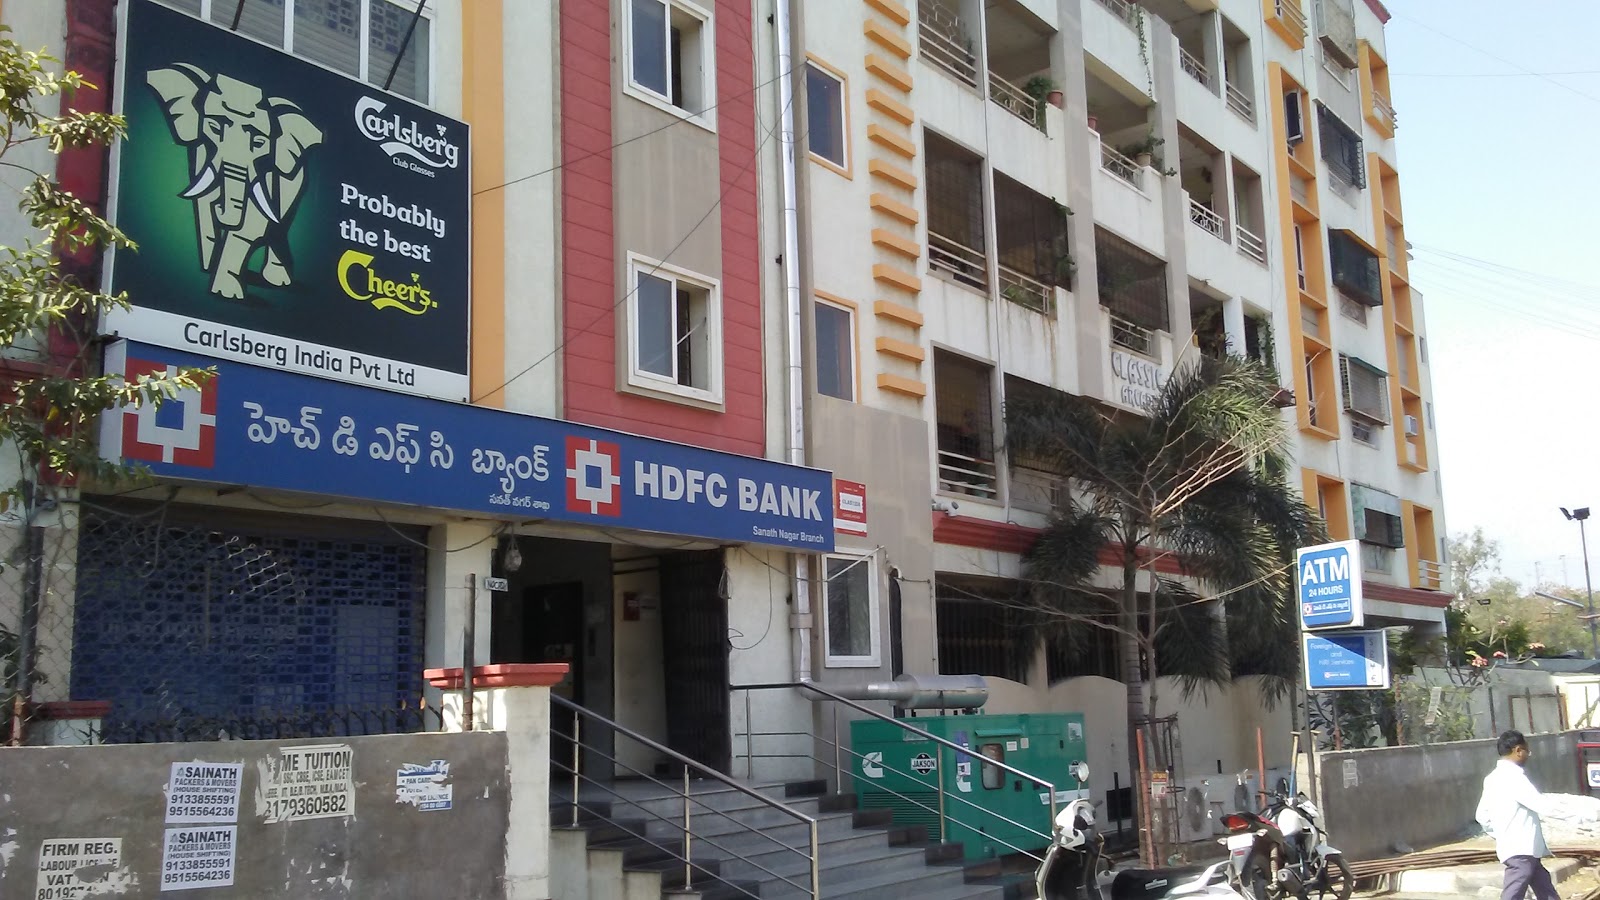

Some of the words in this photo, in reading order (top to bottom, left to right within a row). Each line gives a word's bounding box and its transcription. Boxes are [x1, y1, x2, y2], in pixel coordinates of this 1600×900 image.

[355, 95, 459, 168] Carlsberg
[392, 156, 409, 169] Club
[409, 162, 435, 178] Glasses
[340, 182, 446, 239] Probably
[339, 219, 379, 247] the
[383, 229, 432, 263] best
[184, 322, 288, 366] Carlsberg
[295, 344, 342, 373] India
[350, 356, 381, 380] Pvt
[387, 364, 415, 387] Ltd
[332, 415, 359, 456] డి
[430, 431, 454, 470] సి
[634, 460, 728, 508] HDFC
[738, 477, 823, 522] BANK
[752, 525, 778, 539] Sanath
[779, 529, 799, 542] Nagar
[800, 532, 824, 543] Branch
[1302, 554, 1349, 586] ATM
[1309, 588, 1318, 597] 24
[1318, 585, 1343, 595] HOURS
[282, 753, 299, 771] ME
[305, 751, 351, 770] TUITION
[912, 760, 936, 768] JAKSON
[185, 766, 237, 779] SAINATH
[174, 778, 205, 786] PACKERS
[210, 778, 237, 787] MOVERS
[171, 794, 235, 804] 9133855591
[169, 806, 235, 816] 9515564236
[178, 830, 231, 844] SAINATH
[42, 843, 79, 857] FIRM
[83, 842, 118, 855] REG.
[168, 843, 199, 852] PACKERS
[199, 843, 204, 851] &
[205, 842, 231, 851] MOVERS
[40, 860, 77, 872] LABOUR
[165, 858, 231, 871] 9133855591
[46, 874, 74, 886] VAT
[164, 870, 231, 884] 9515564236
